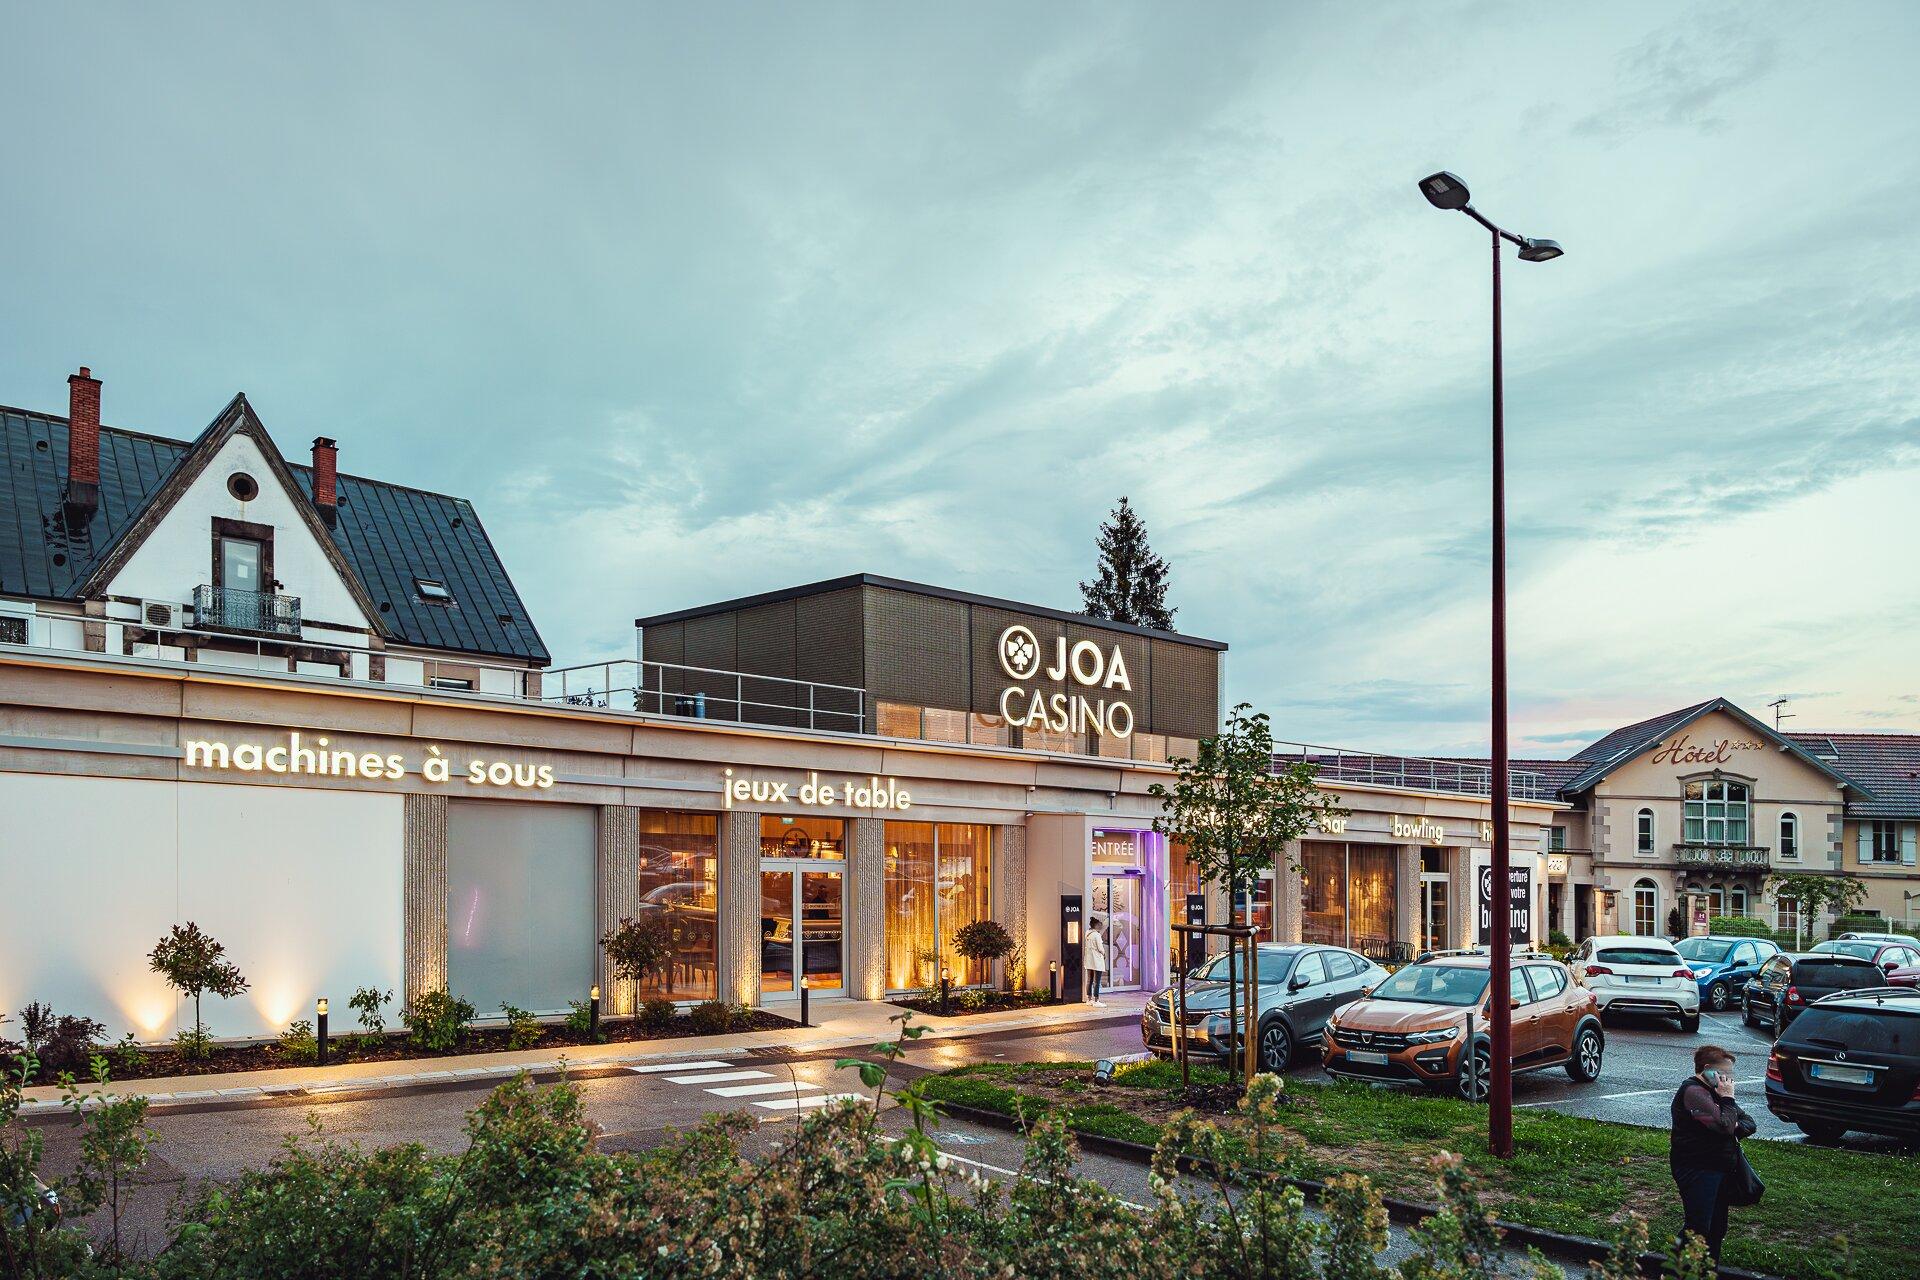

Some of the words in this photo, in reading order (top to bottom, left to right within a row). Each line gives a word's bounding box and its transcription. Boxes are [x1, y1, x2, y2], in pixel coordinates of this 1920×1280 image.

[1046, 636, 1132, 692] JOA
[1000, 686, 1134, 739] CASINO
[185, 732, 406, 780] machines
[422, 745, 450, 783] à
[467, 758, 555, 788] sous
[1652, 734, 1732, 765] Hôtel
[724, 768, 790, 809] jeux
[799, 772, 835, 806] de
[844, 777, 912, 810] table
[1394, 814, 1444, 845] bowling
[1092, 841, 1135, 856] ENTRÉE
[1510, 887, 1526, 899] votre
[1481, 904, 1528, 934] bing
